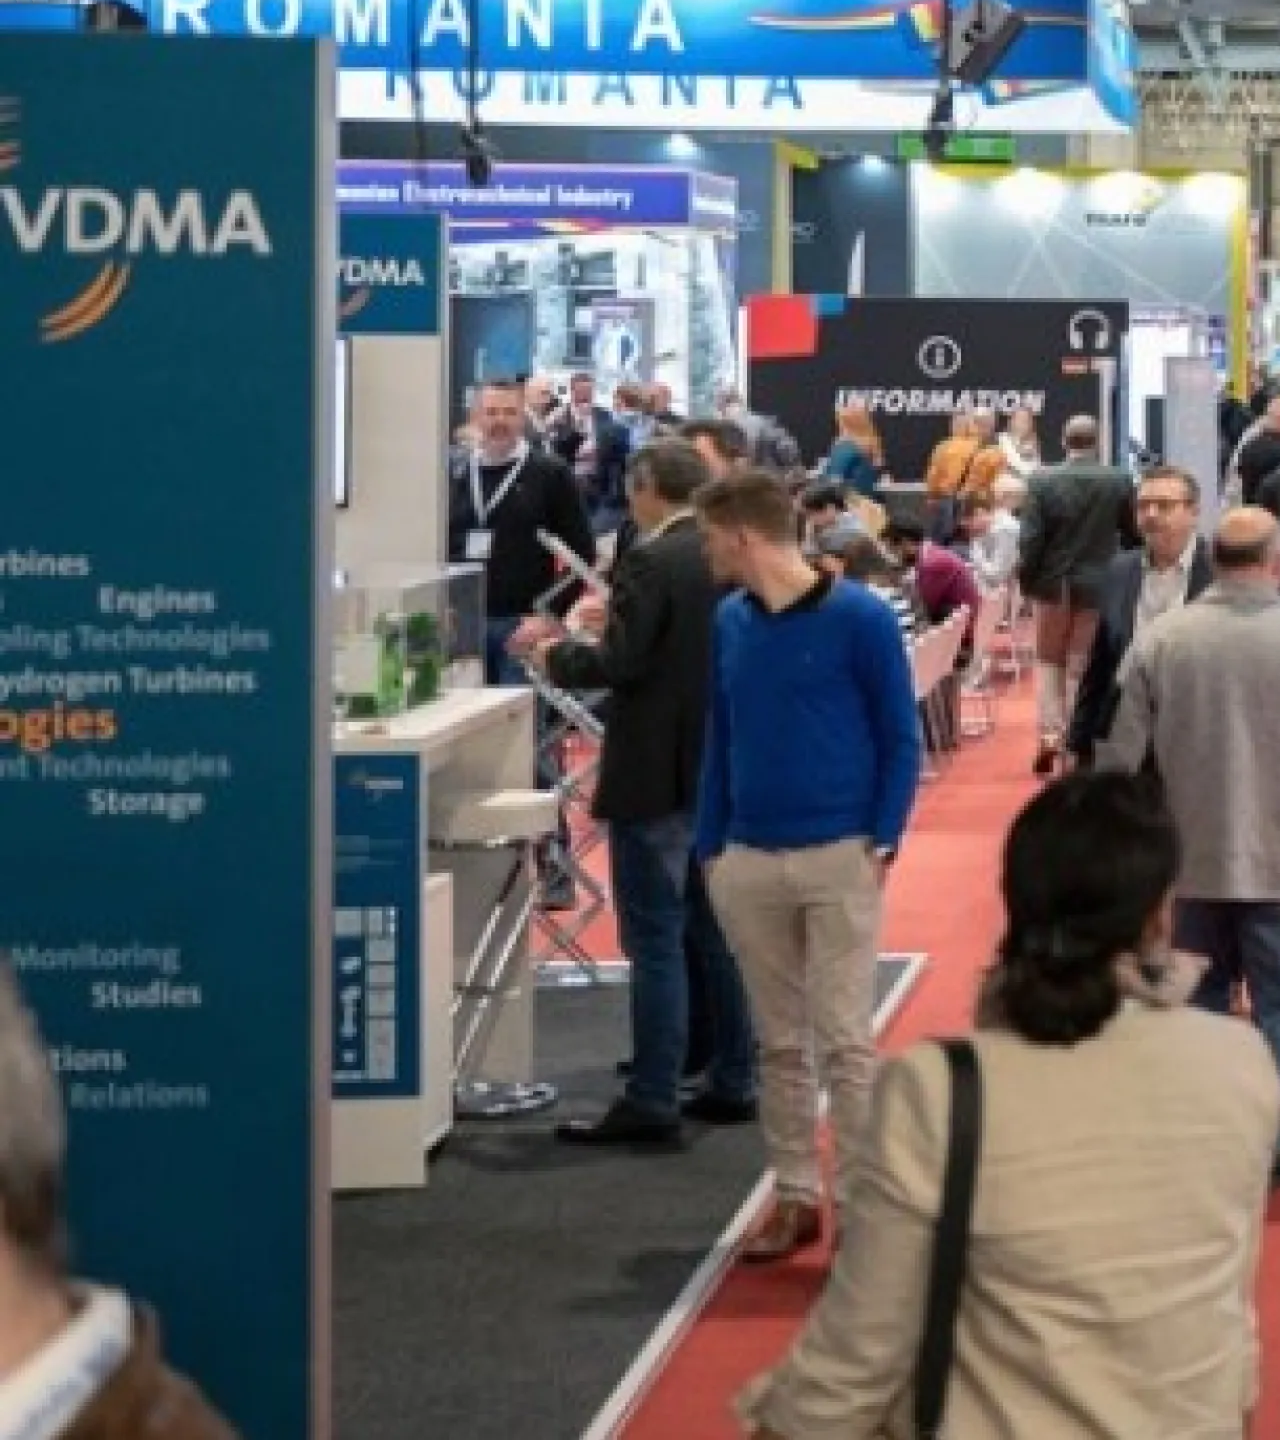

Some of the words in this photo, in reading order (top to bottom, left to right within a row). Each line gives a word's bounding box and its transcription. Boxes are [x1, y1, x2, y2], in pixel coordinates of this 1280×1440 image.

[2, 187, 272, 253] VDMA
[340, 257, 425, 286] DMA
[835, 388, 1046, 417] INFORMATION
[100, 584, 216, 620] Engines
[80, 626, 269, 658] Technologies
[129, 666, 255, 694] Turbines
[38, 754, 231, 786] Technologies
[87, 790, 205, 821] Storage
[12, 943, 181, 974] Monitoring
[92, 981, 202, 1009] Studies
[68, 1082, 208, 1109] Relations
